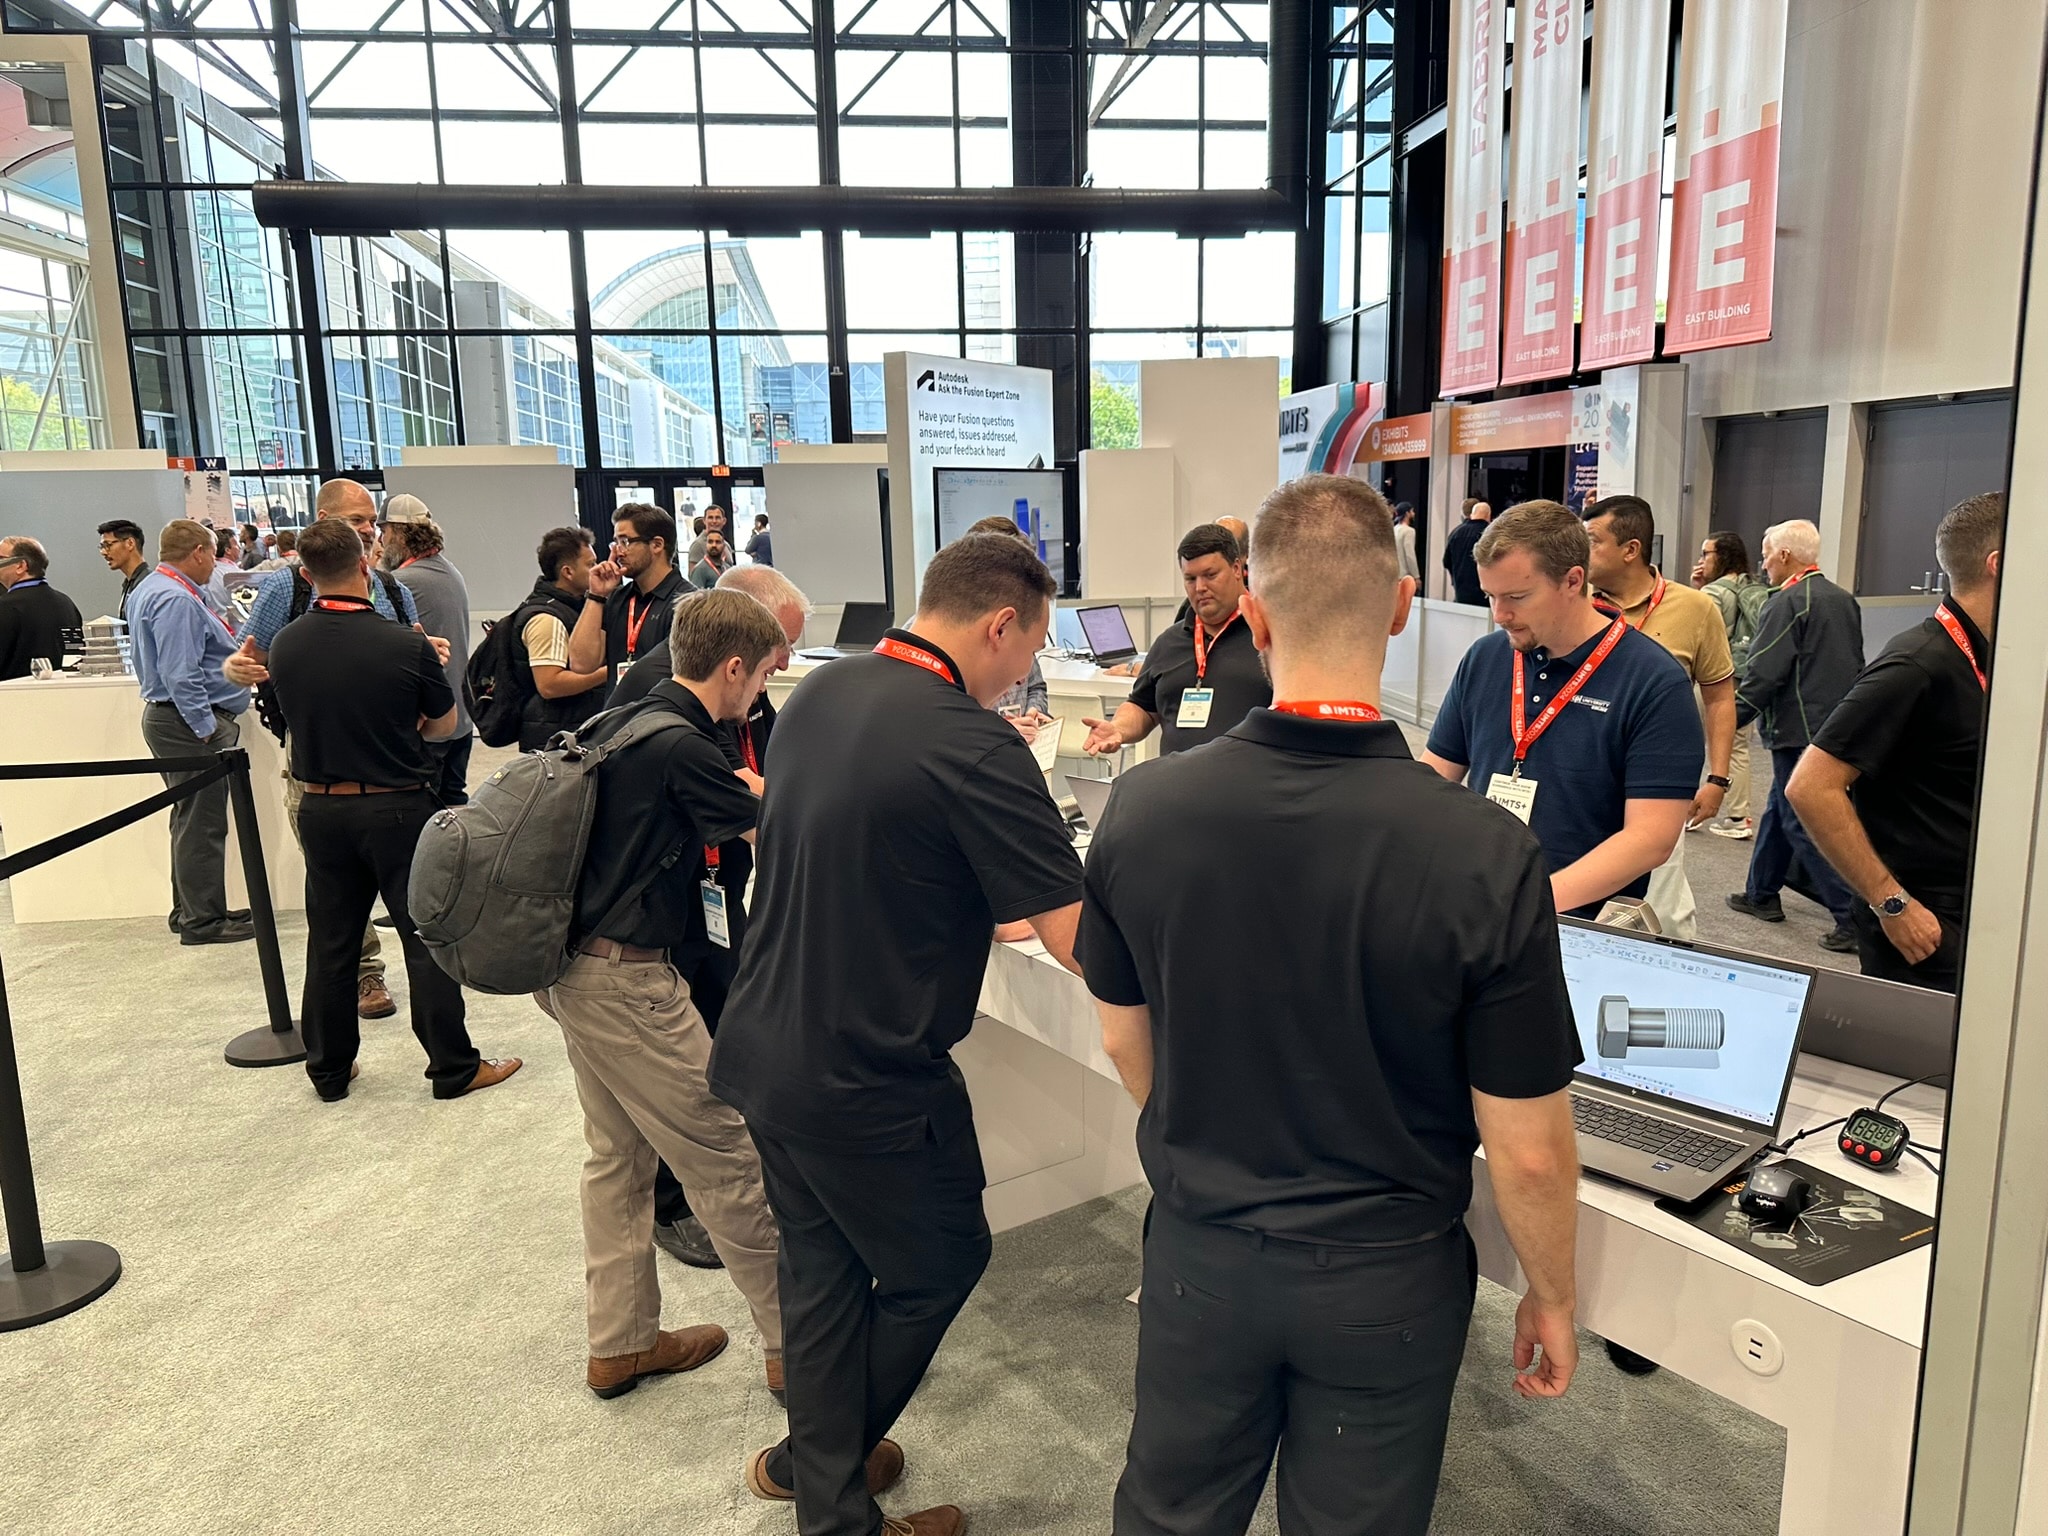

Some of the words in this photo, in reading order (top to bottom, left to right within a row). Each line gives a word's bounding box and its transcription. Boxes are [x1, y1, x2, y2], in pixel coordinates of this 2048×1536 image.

[1696, 179, 1750, 292] E
[1603, 218, 1640, 315] E
[1523, 250, 1558, 336] E
[1457, 276, 1486, 352] E
[1685, 313, 1706, 325] EAST
[1707, 303, 1750, 321] BUILDING
[1594, 332, 1610, 345] EAST
[1515, 352, 1530, 362] EAST
[1531, 346, 1560, 358] BUILDING
[938, 371, 969, 384] Autodesk
[938, 384, 951, 394] Ask
[951, 386, 962, 395] the
[963, 387, 984, 397] Fusion
[985, 388, 1005, 400] Expert
[1005, 390, 1020, 400] Zone
[918, 410, 938, 422] Have
[939, 412, 956, 425] your
[957, 413, 981, 425] Fusion
[981, 415, 1015, 428] questions
[919, 428, 957, 441] answered,
[958, 428, 980, 440] issues
[981, 431, 1018, 444] addressed,
[1382, 426, 1409, 440] EXHIBITS
[920, 443, 934, 454] and
[935, 445, 952, 457] your
[953, 443, 985, 456] feedback
[986, 446, 1006, 457] heard
[177, 459, 185, 468] E
[204, 459, 217, 467] W
[892, 645, 933, 665] IMTS2024
[1560, 669, 1588, 701] IMTS2024
[1499, 797, 1527, 809] IMTS+
